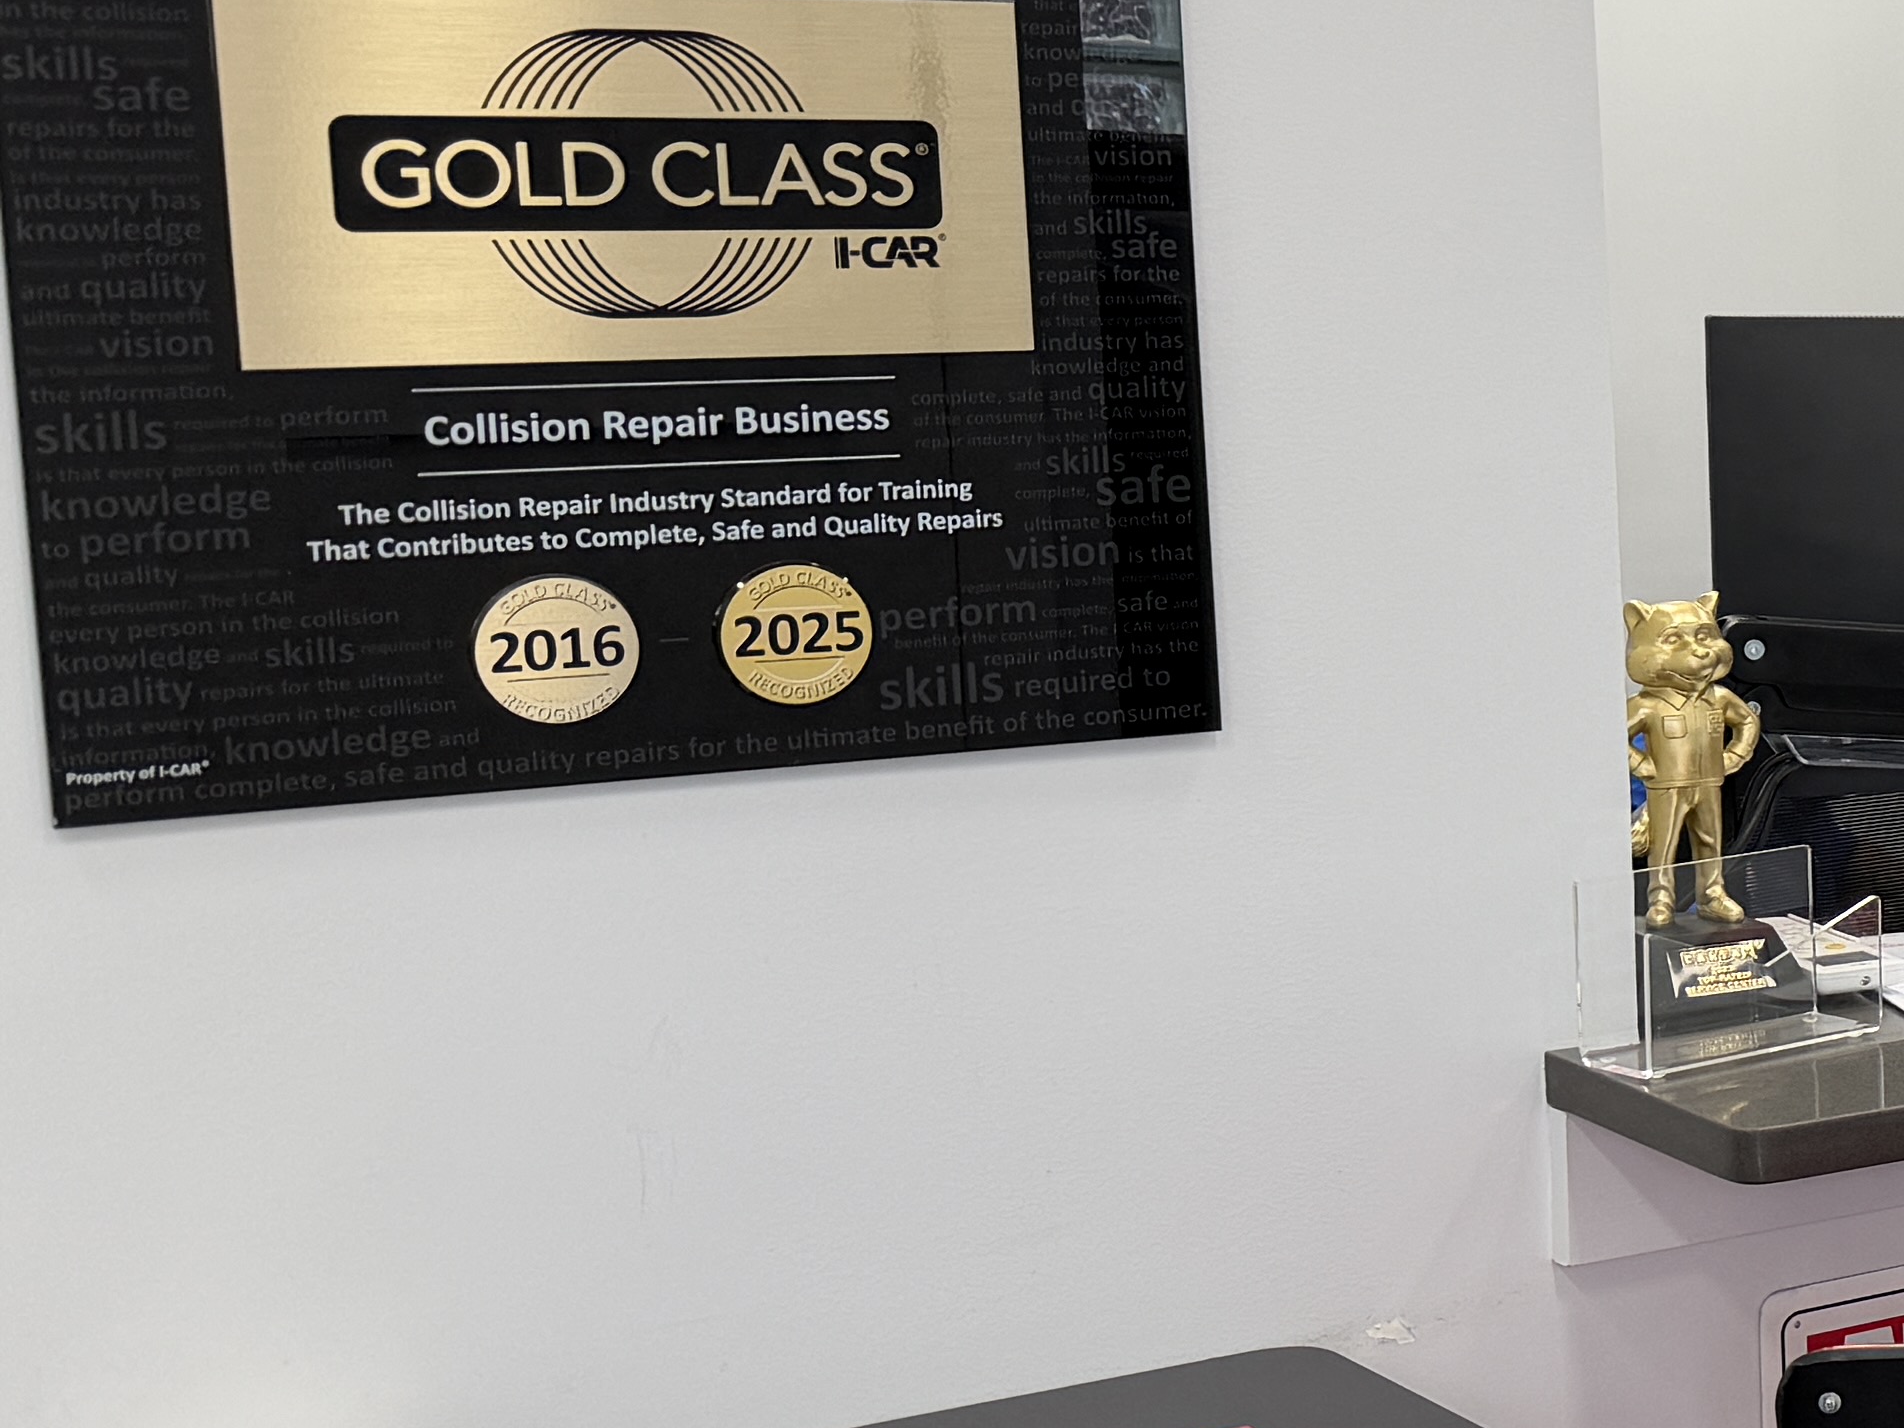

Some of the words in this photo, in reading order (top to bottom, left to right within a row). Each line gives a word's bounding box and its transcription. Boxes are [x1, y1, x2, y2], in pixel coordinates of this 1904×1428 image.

[360, 140, 626, 209] GOLD
[650, 140, 915, 207] CLASS
[835, 236, 939, 270] I-CAR
[423, 409, 592, 446] Collision
[602, 405, 723, 450] Repair
[734, 400, 890, 436] Business
[40, 483, 272, 523] knowledge
[339, 503, 390, 527] The
[398, 497, 512, 524] Collision
[518, 493, 601, 523] Repair
[609, 488, 714, 518] Industry
[721, 483, 831, 510] Standard
[838, 481, 872, 503] for
[879, 478, 974, 507] Training
[308, 540, 370, 564] That
[378, 530, 533, 560] Contributes
[541, 530, 568, 551] to
[575, 521, 704, 553] Complete,
[712, 518, 764, 542] Safe
[771, 514, 817, 538] and
[824, 511, 910, 542] Quality
[918, 507, 1003, 538] Repairs
[490, 625, 626, 675] 2016
[733, 610, 866, 661] 2025
[65, 770, 135, 788] Property
[139, 766, 155, 781] of
